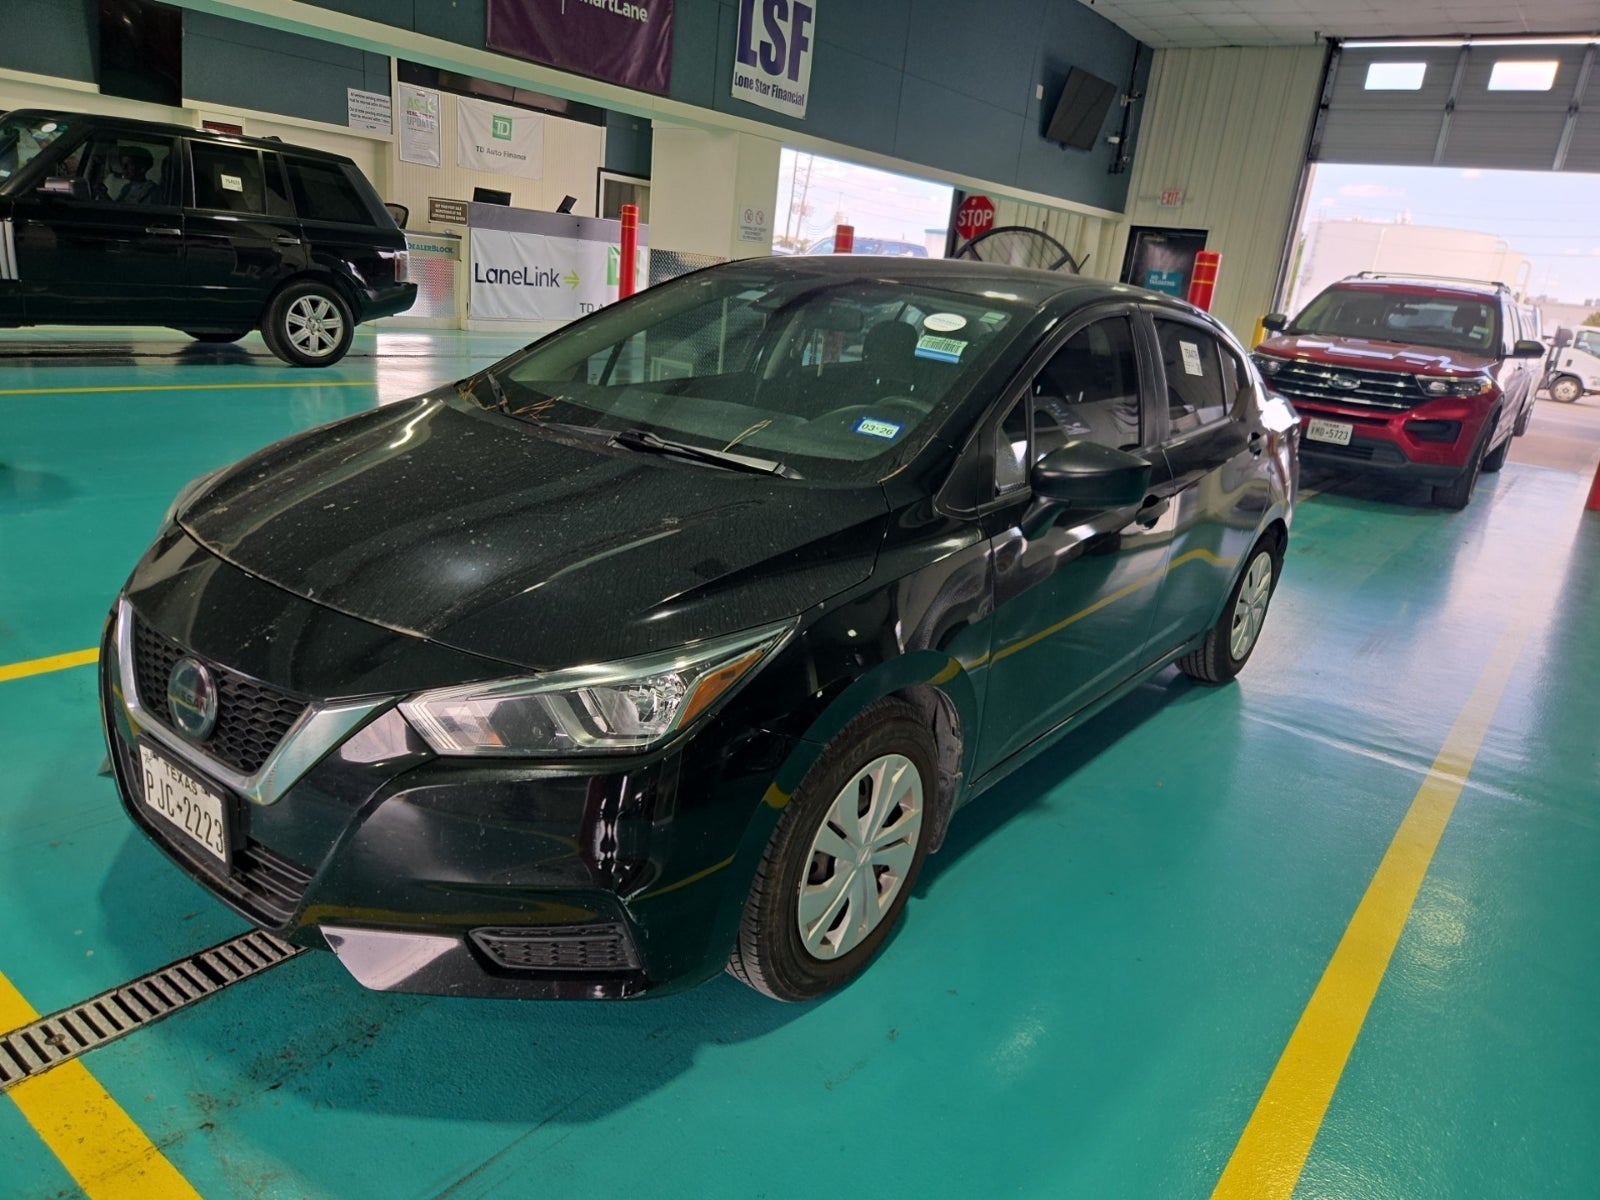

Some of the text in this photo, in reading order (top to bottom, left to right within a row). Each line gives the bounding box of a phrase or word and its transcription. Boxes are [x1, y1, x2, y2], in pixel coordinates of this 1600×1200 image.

[580, 0, 648, 22] artLane
[737, 0, 813, 82] LSF
[734, 72, 805, 106] Lone Star Financial
[494, 118, 511, 136] TD
[476, 145, 527, 161] TD Auto Finance
[957, 208, 993, 227] STOP
[474, 262, 561, 288] LaneLink
[579, 302, 595, 314] TD
[163, 761, 198, 796] TEXAS
